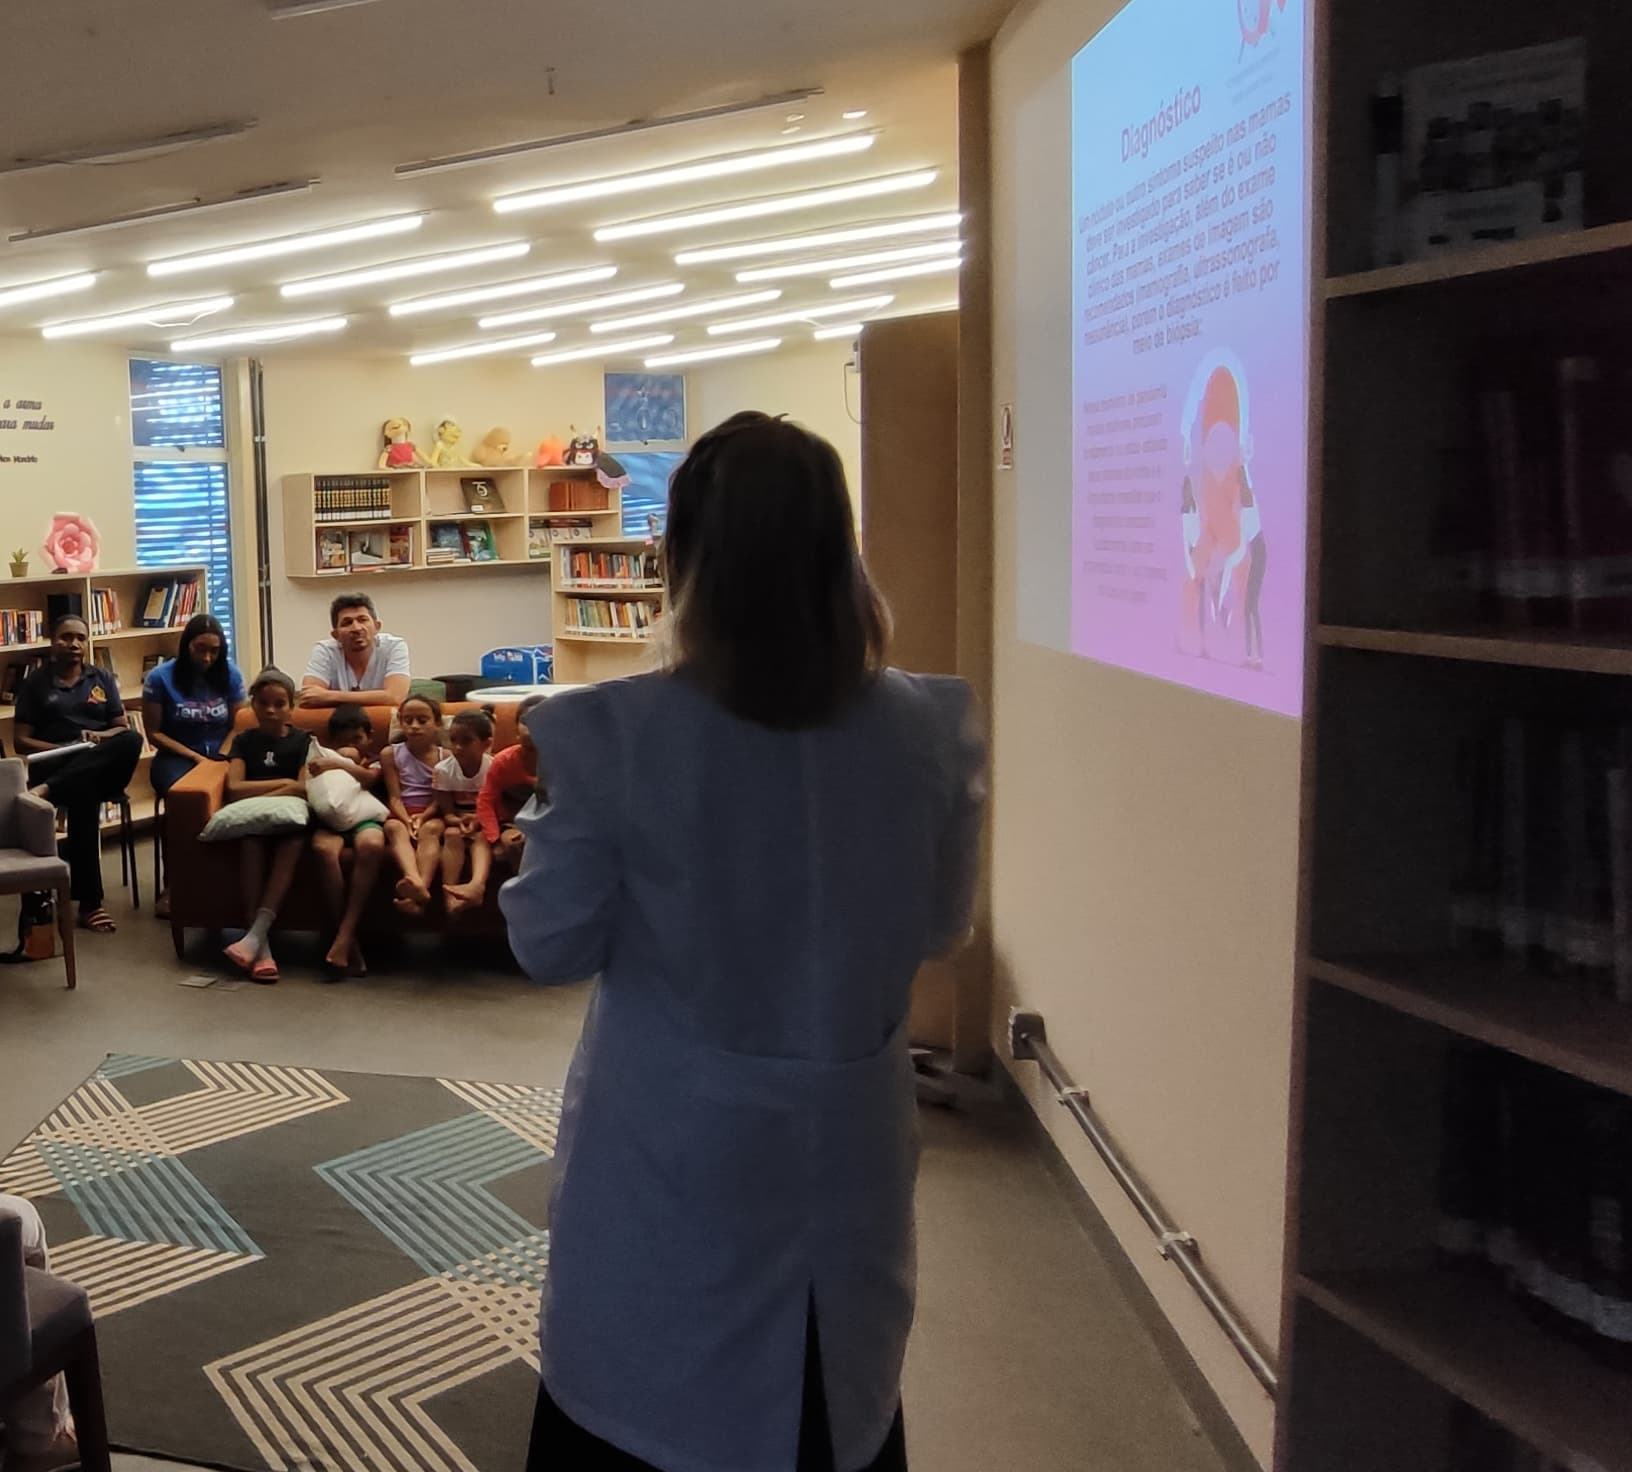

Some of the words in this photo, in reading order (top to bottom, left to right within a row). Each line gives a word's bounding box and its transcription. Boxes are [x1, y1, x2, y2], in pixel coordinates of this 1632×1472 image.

[1121, 84, 1201, 163] Diagnóstico
[1183, 133, 1225, 173] suspeito
[1227, 119, 1246, 147] nas
[1248, 91, 1292, 134] mamas
[1213, 162, 1226, 185] se
[1237, 147, 1252, 171] ou
[1255, 132, 1277, 161] não
[1221, 184, 1236, 209] do
[1238, 165, 1276, 201] exame
[1252, 197, 1273, 225] são
[1259, 259, 1281, 292] por
[3, 399, 11, 410] a
